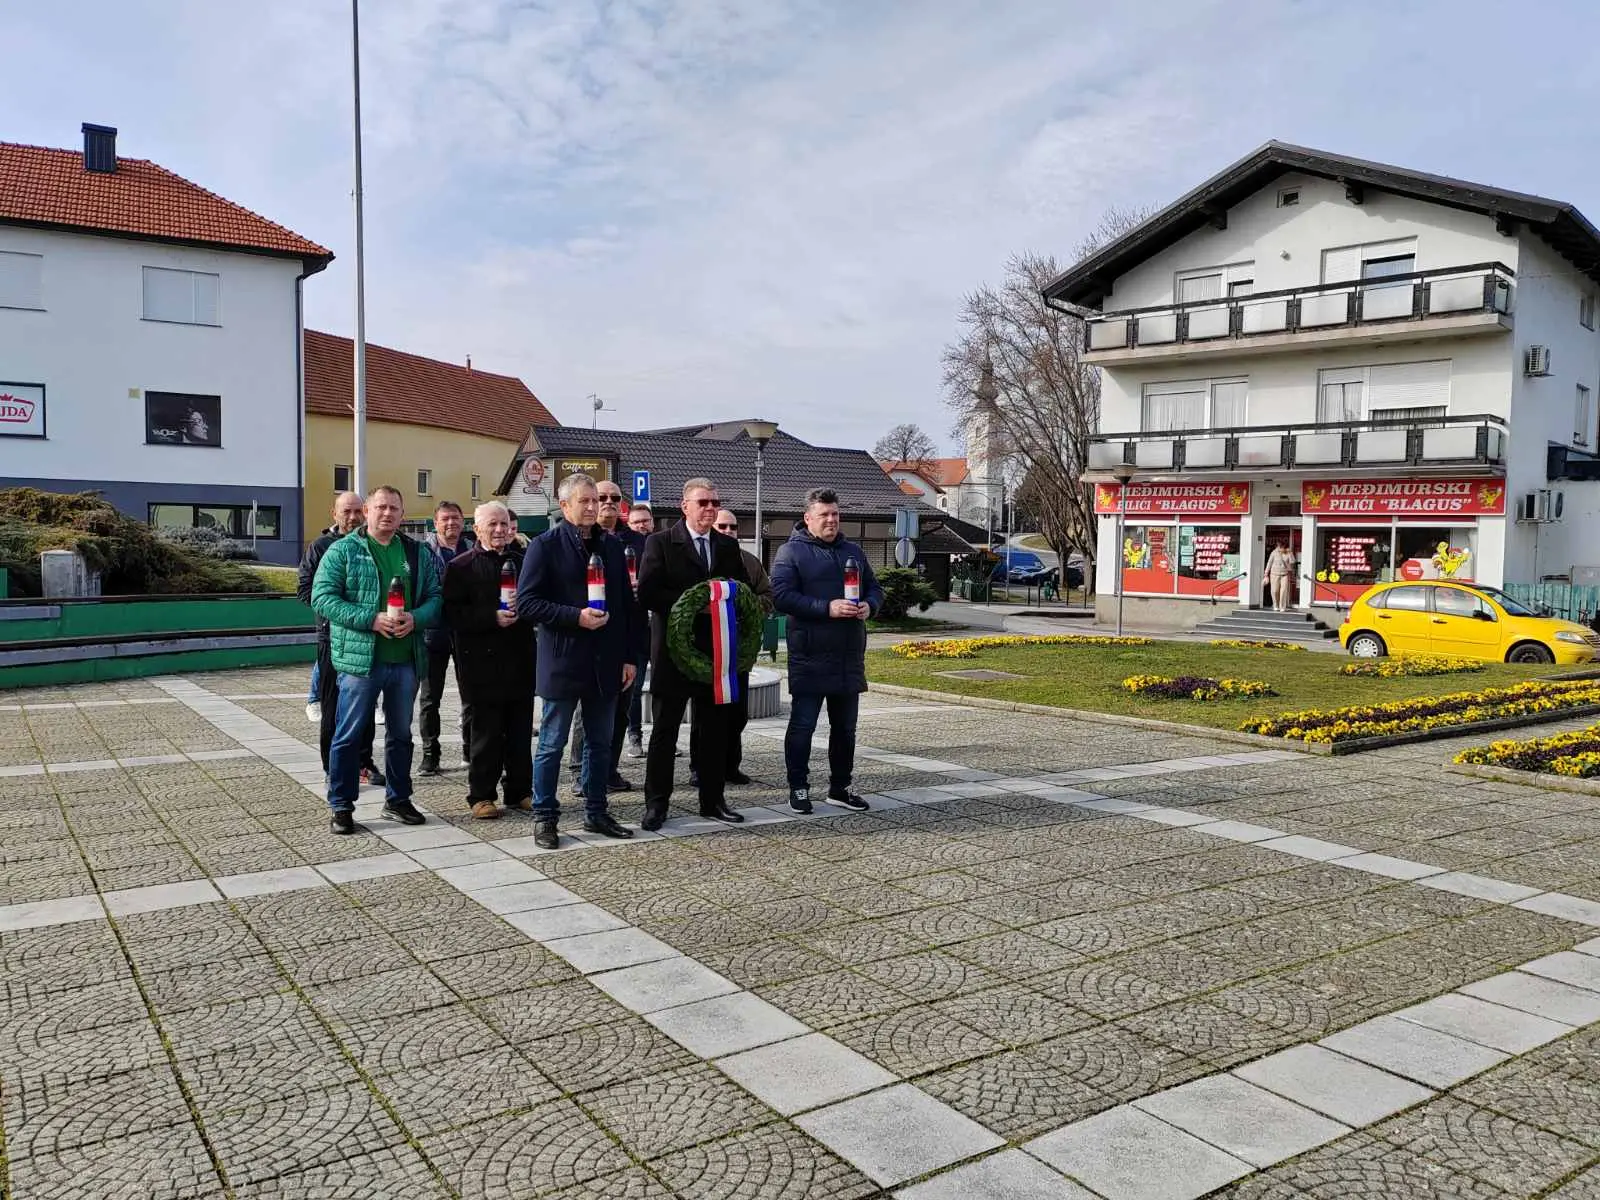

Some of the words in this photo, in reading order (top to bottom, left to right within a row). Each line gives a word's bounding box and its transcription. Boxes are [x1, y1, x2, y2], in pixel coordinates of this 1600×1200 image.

[636, 477, 646, 497] P
[1330, 482, 1473, 496] MEĐIMURSKI
[1329, 495, 1376, 511] PILIĆI
